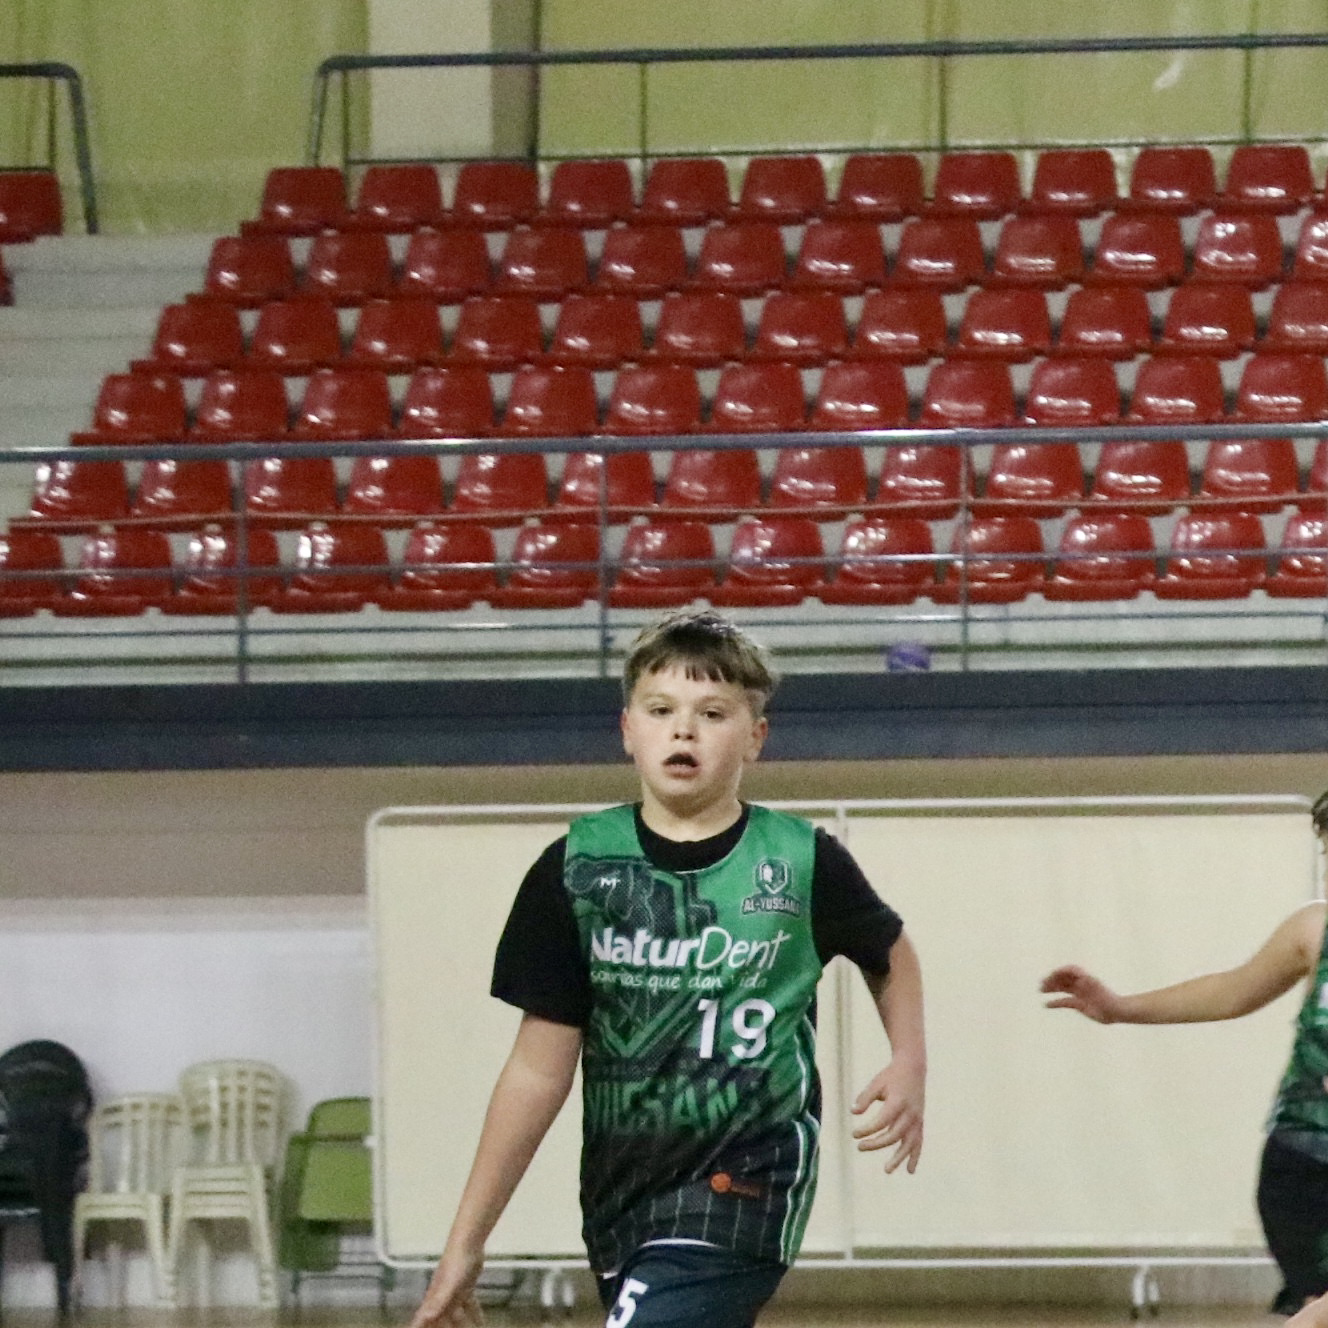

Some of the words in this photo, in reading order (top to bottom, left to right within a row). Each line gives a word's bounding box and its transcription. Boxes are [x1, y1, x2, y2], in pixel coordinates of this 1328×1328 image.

[591, 926, 792, 970] NaturDent
[649, 973, 681, 996] que
[688, 968, 723, 989] dan
[698, 998, 776, 1059] 19
